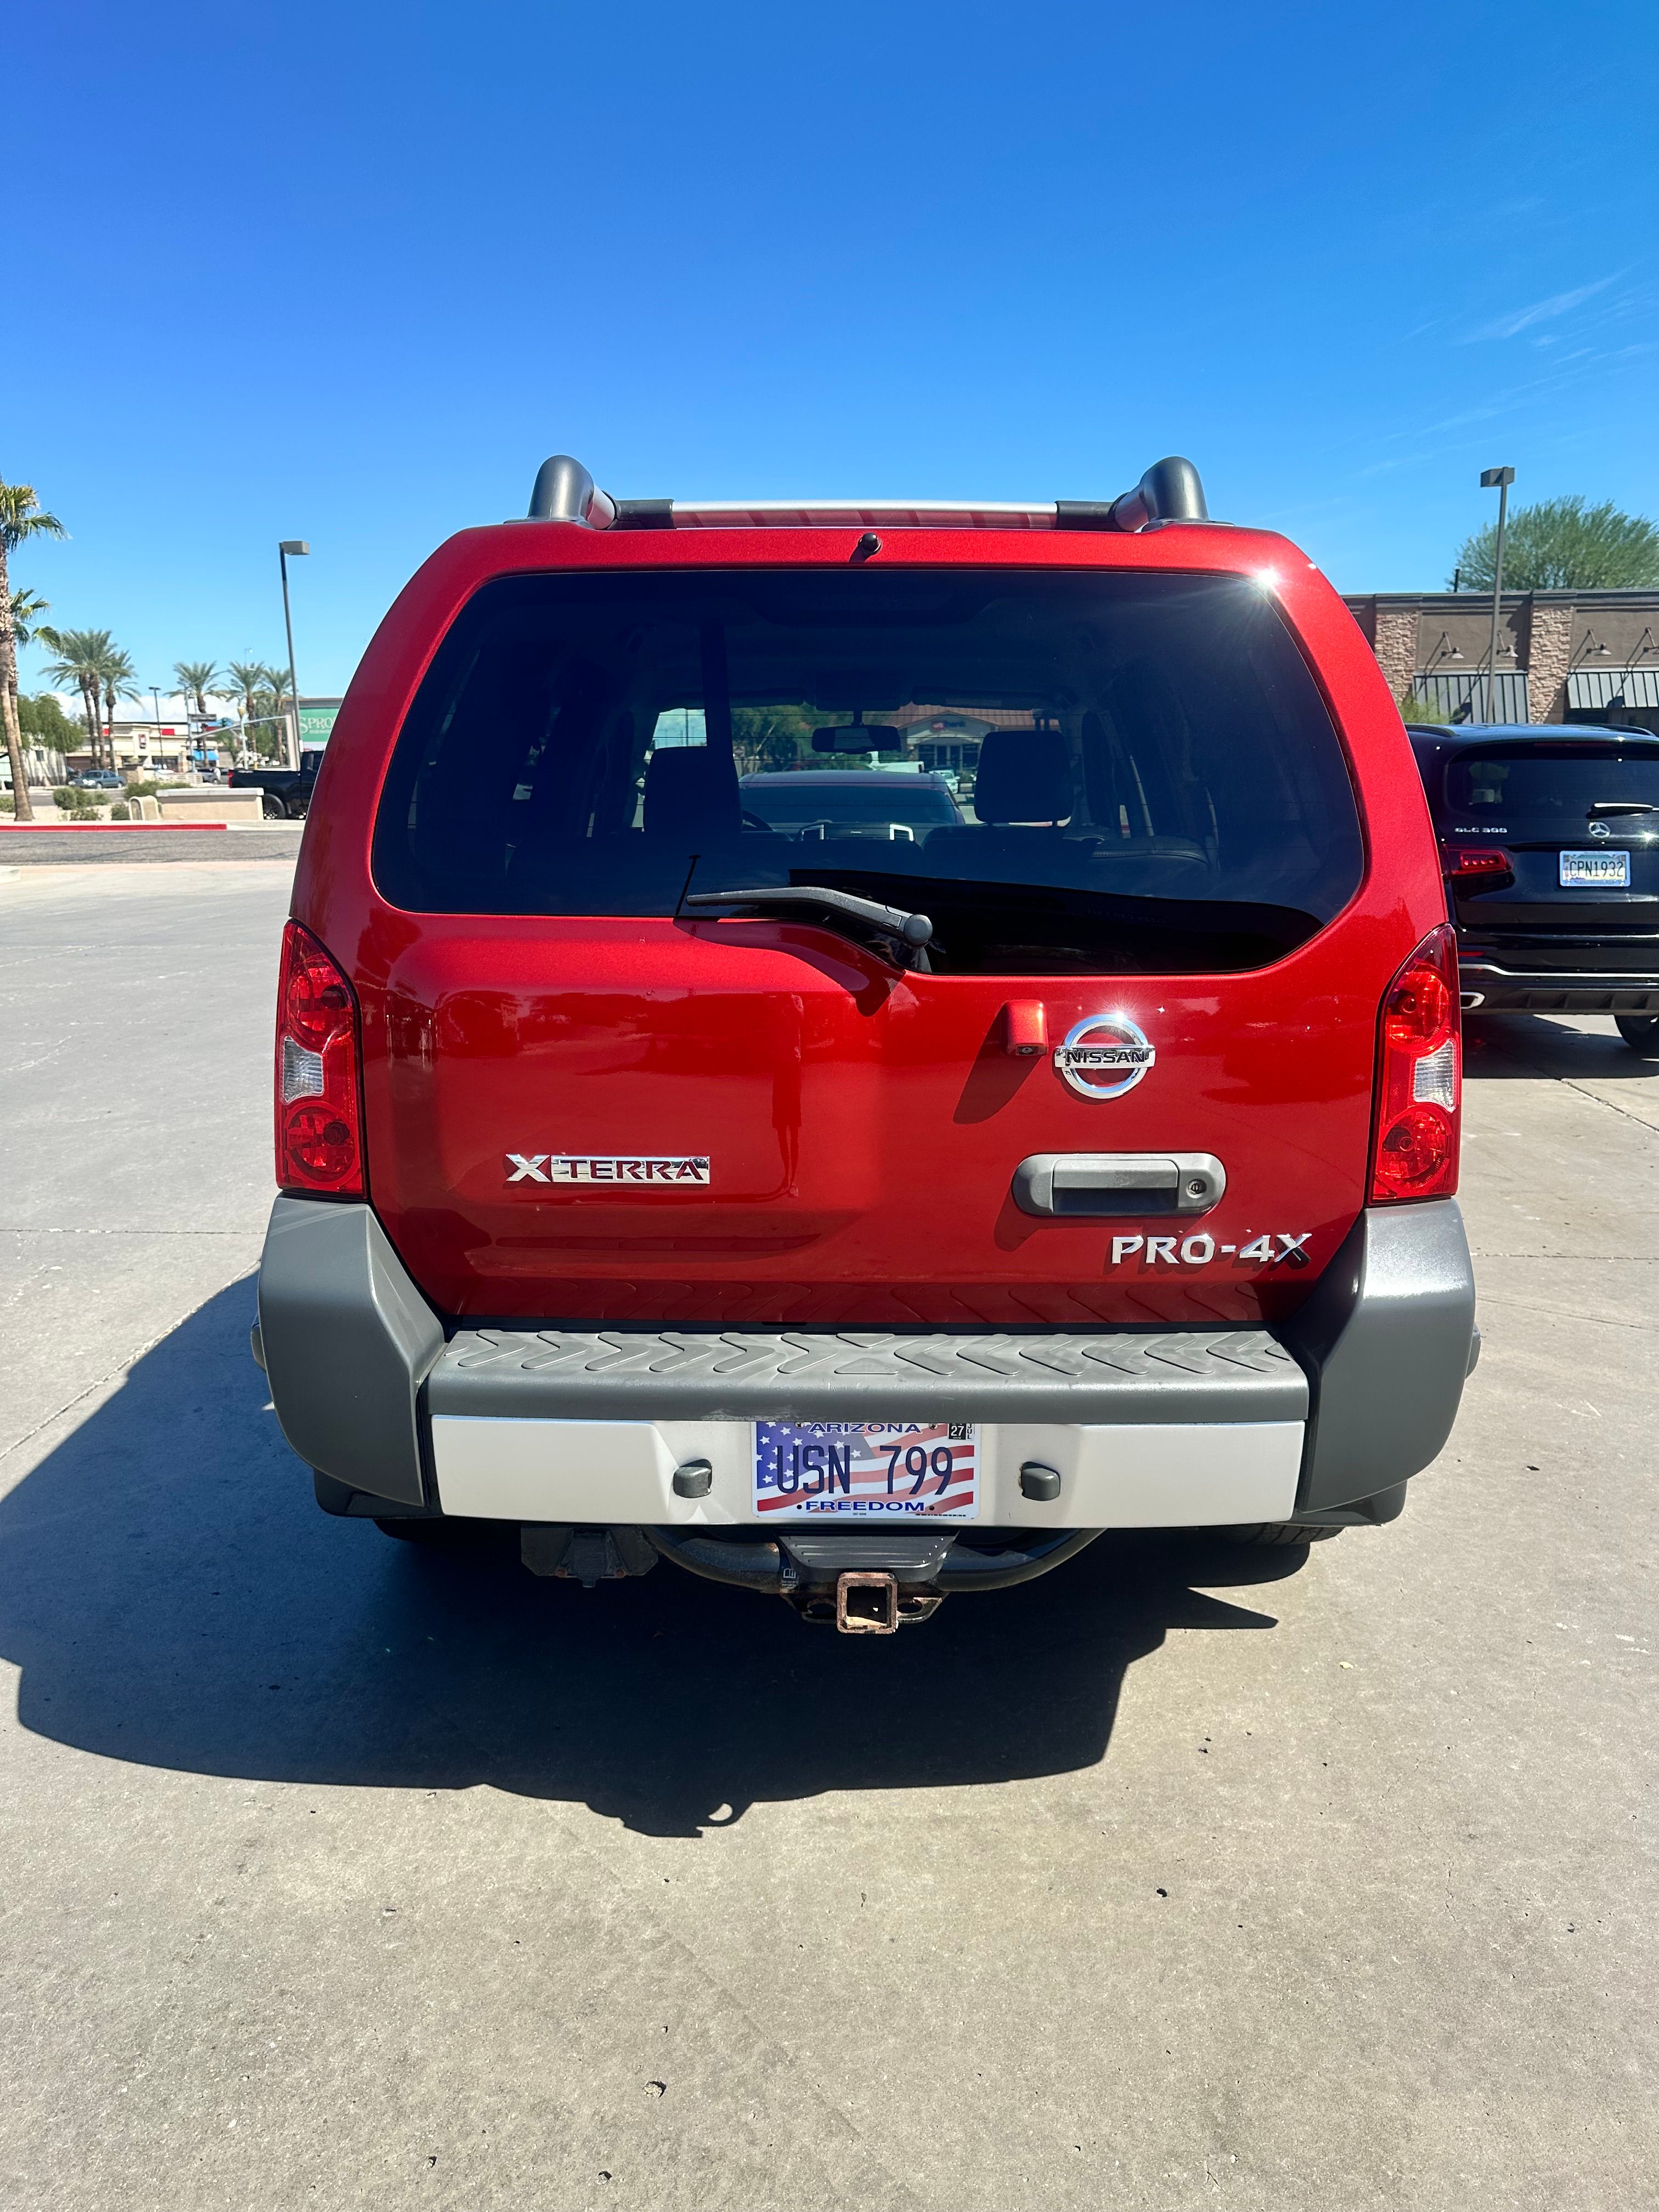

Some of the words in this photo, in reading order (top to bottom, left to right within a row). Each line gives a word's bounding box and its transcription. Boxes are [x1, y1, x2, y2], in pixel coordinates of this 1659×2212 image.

[299, 717, 336, 734] SPRO
[1570, 861, 1624, 877] CPN1932
[1066, 1051, 1146, 1063] NISSAN
[1111, 1233, 1312, 1264] PRO-4X
[809, 1423, 921, 1432] ARIZONA
[951, 1425, 964, 1436] 27
[777, 1445, 850, 1494] USN
[879, 1445, 953, 1495] 799
[806, 1501, 924, 1511] FREEDOM
